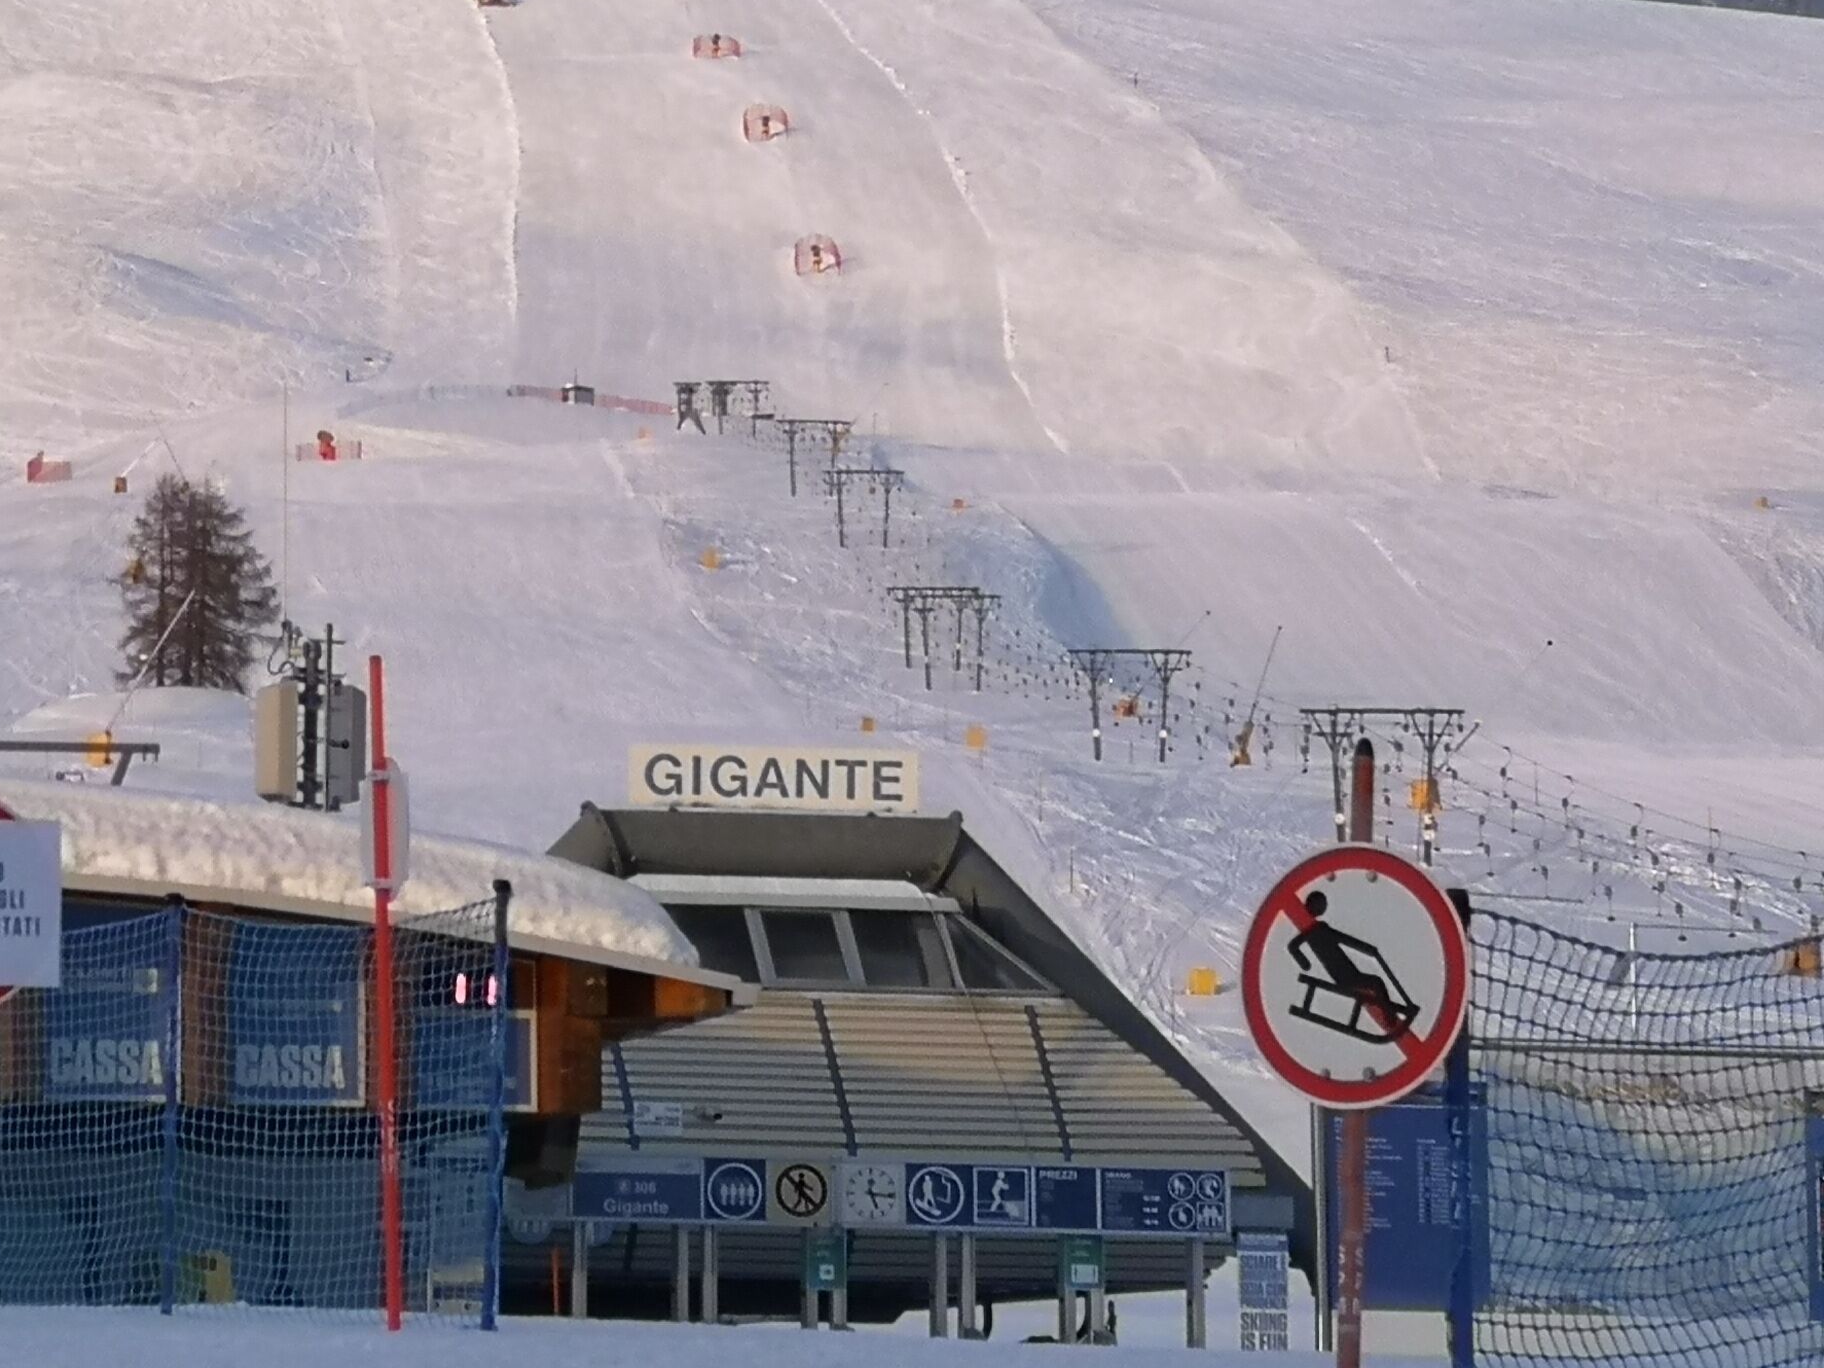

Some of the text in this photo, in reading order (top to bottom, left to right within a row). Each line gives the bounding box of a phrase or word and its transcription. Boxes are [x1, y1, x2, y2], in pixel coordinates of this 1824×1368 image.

[644, 752, 904, 803] GIGANTE
[50, 1038, 164, 1085] CASSA
[236, 1043, 346, 1090] CASSA
[603, 1197, 670, 1218] Gigante
[1240, 1332, 1289, 1352] IS FUN
